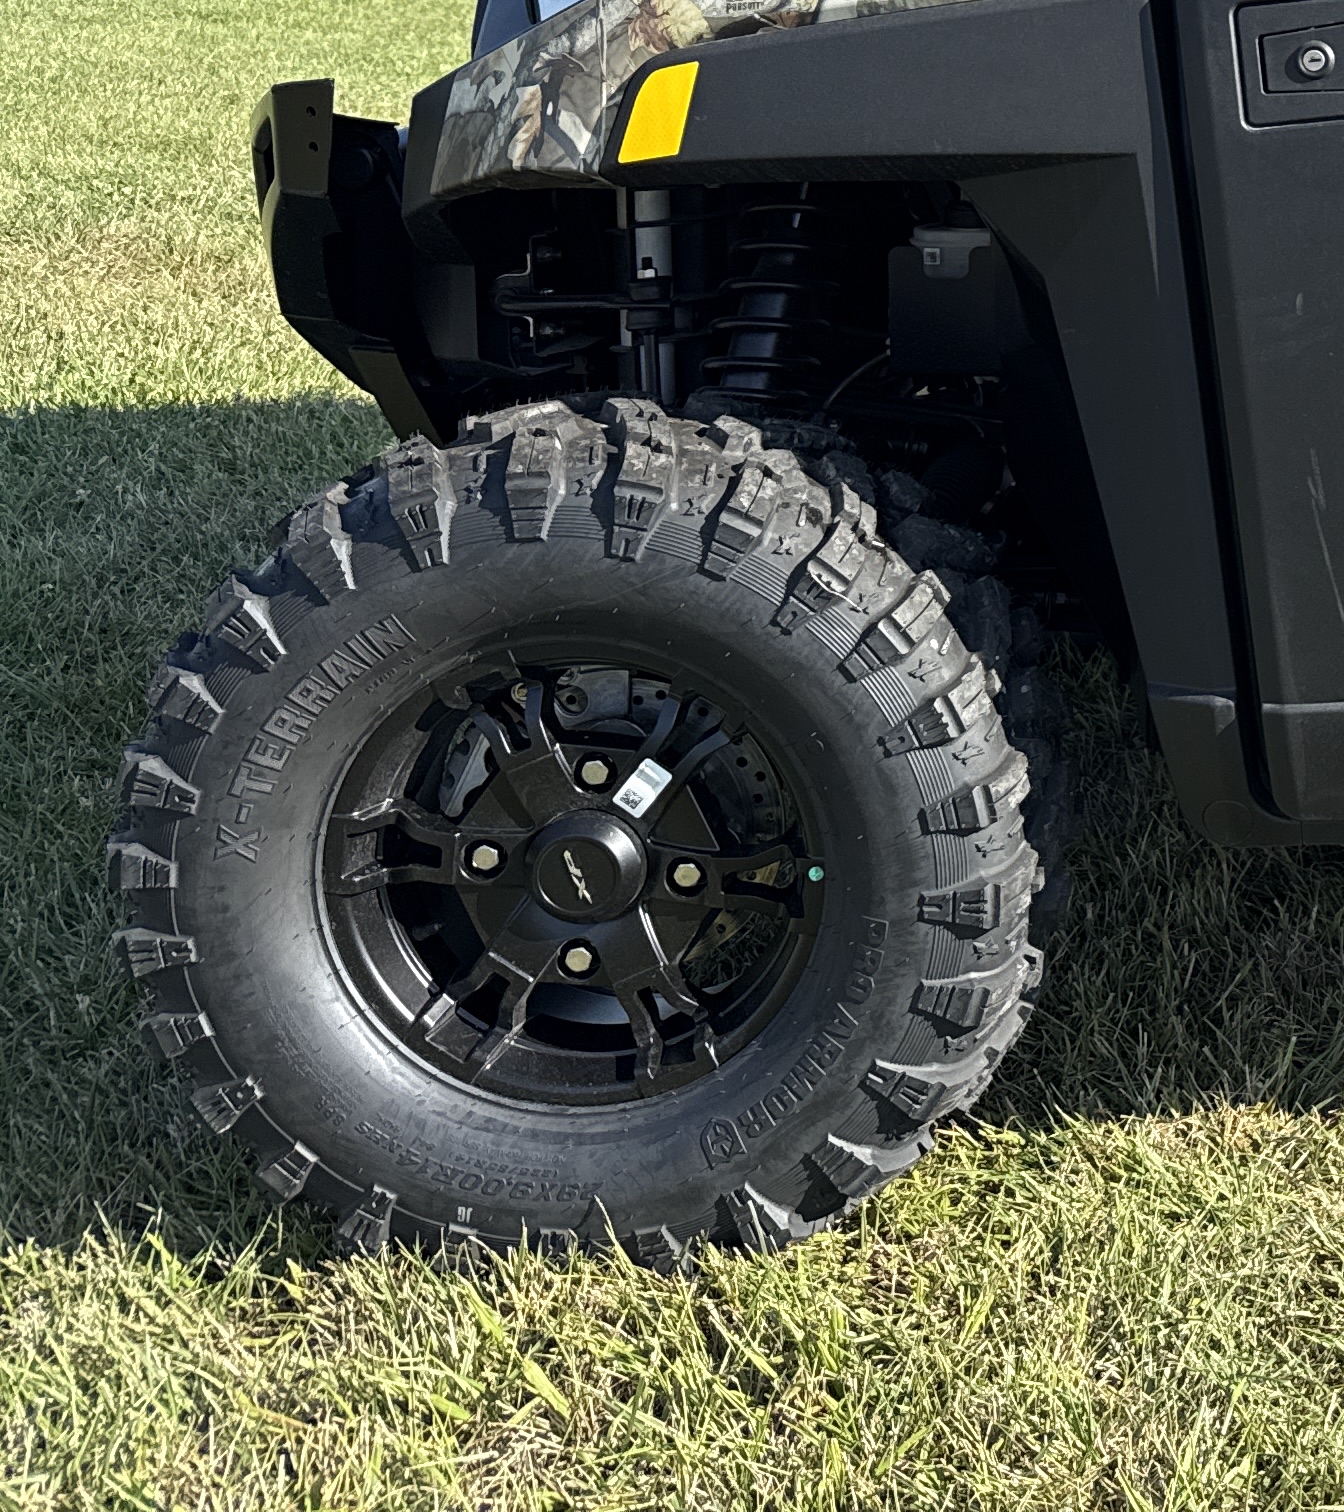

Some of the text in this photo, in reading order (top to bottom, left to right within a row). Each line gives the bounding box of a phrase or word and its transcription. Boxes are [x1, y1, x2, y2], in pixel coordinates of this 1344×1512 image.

[213, 614, 417, 863] X-TERRAIN
[563, 849, 593, 905] XP
[736, 914, 890, 1141] PRO ARMOR
